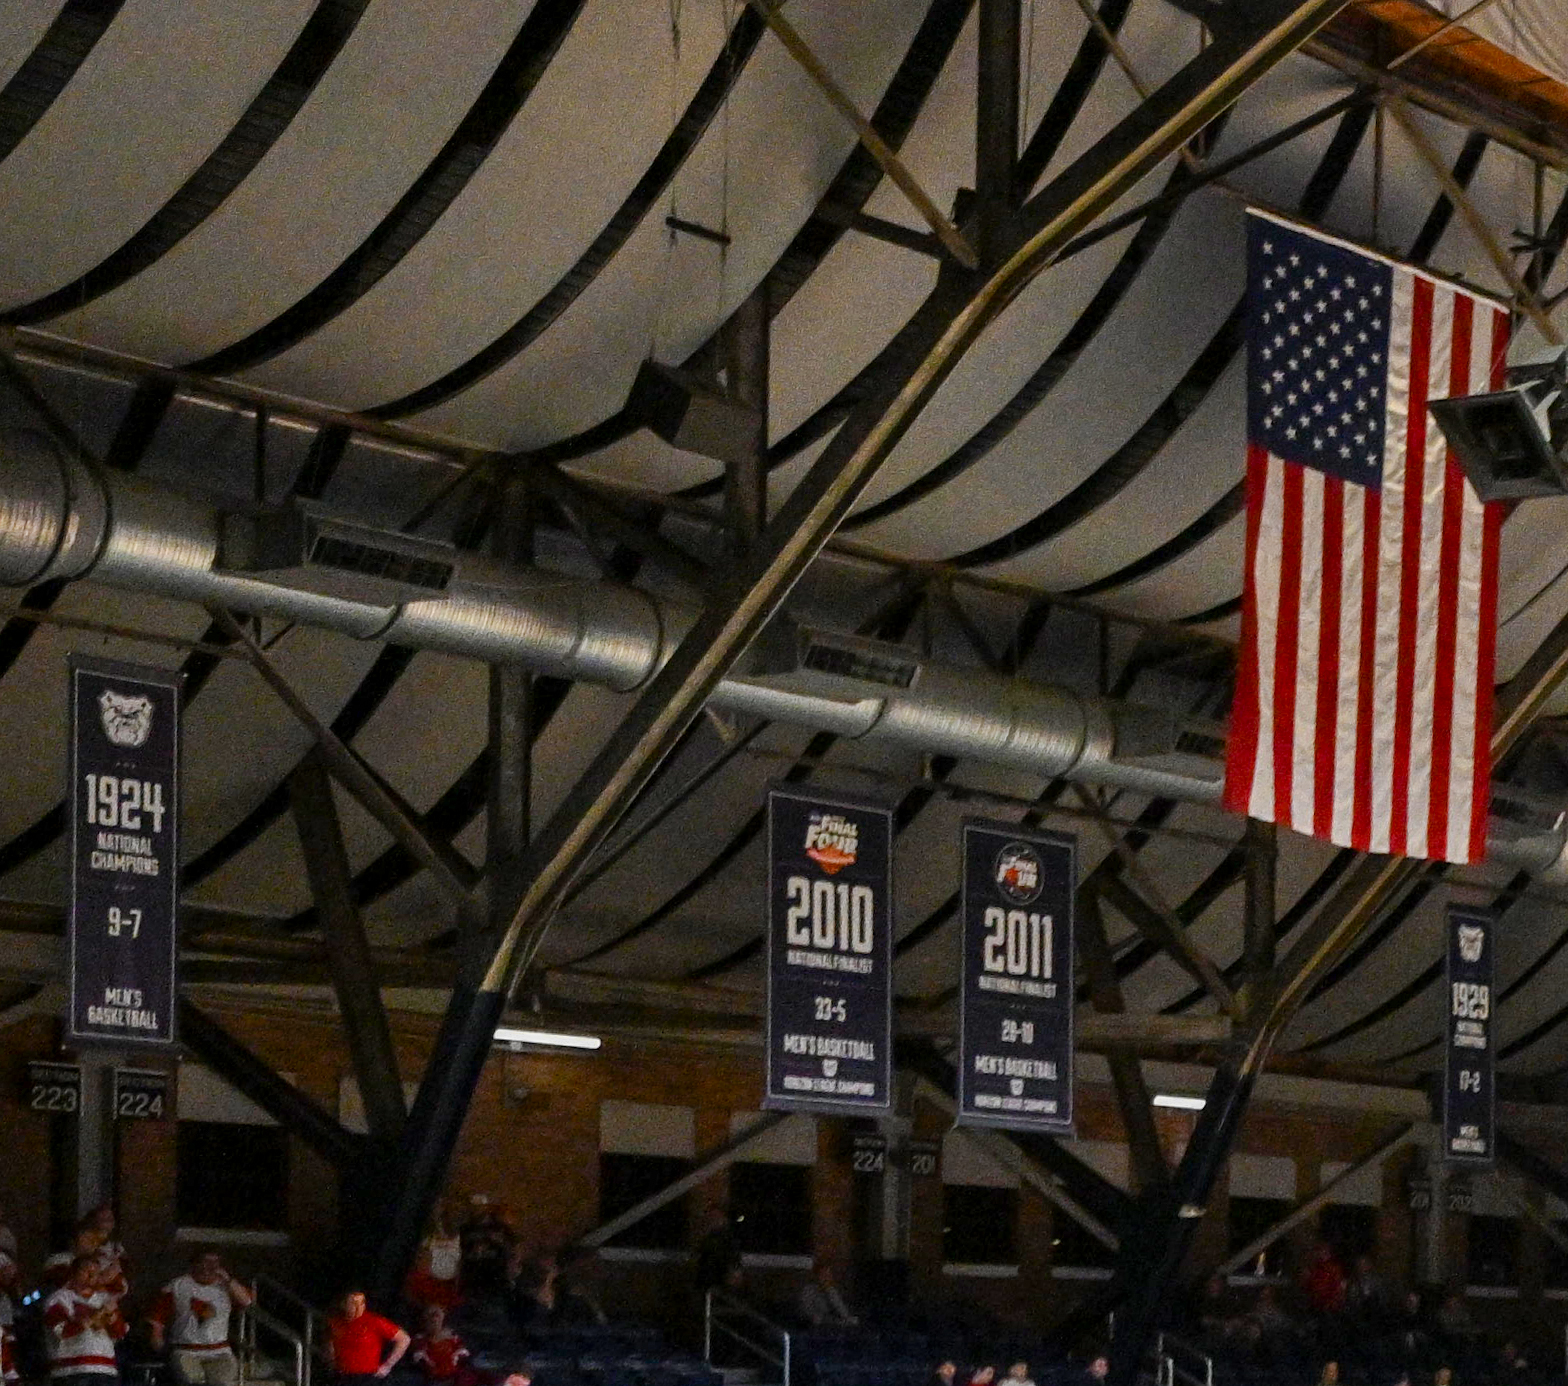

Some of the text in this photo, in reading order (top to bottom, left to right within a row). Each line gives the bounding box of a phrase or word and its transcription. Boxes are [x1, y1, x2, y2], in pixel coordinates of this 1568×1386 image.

[85, 773, 166, 833] 1924
[97, 832, 153, 856] NATIONAL
[90, 851, 160, 876] CHAMPIONS
[107, 907, 142, 939] 9-7
[786, 875, 874, 954] 2010
[984, 906, 1053, 979] 2011
[104, 987, 143, 1008] MEN'S
[1452, 982, 1490, 1020] 1929
[87, 1004, 159, 1030] BASKETBALL
[31, 1085, 78, 1113] 223
[119, 1092, 164, 1118] 224
